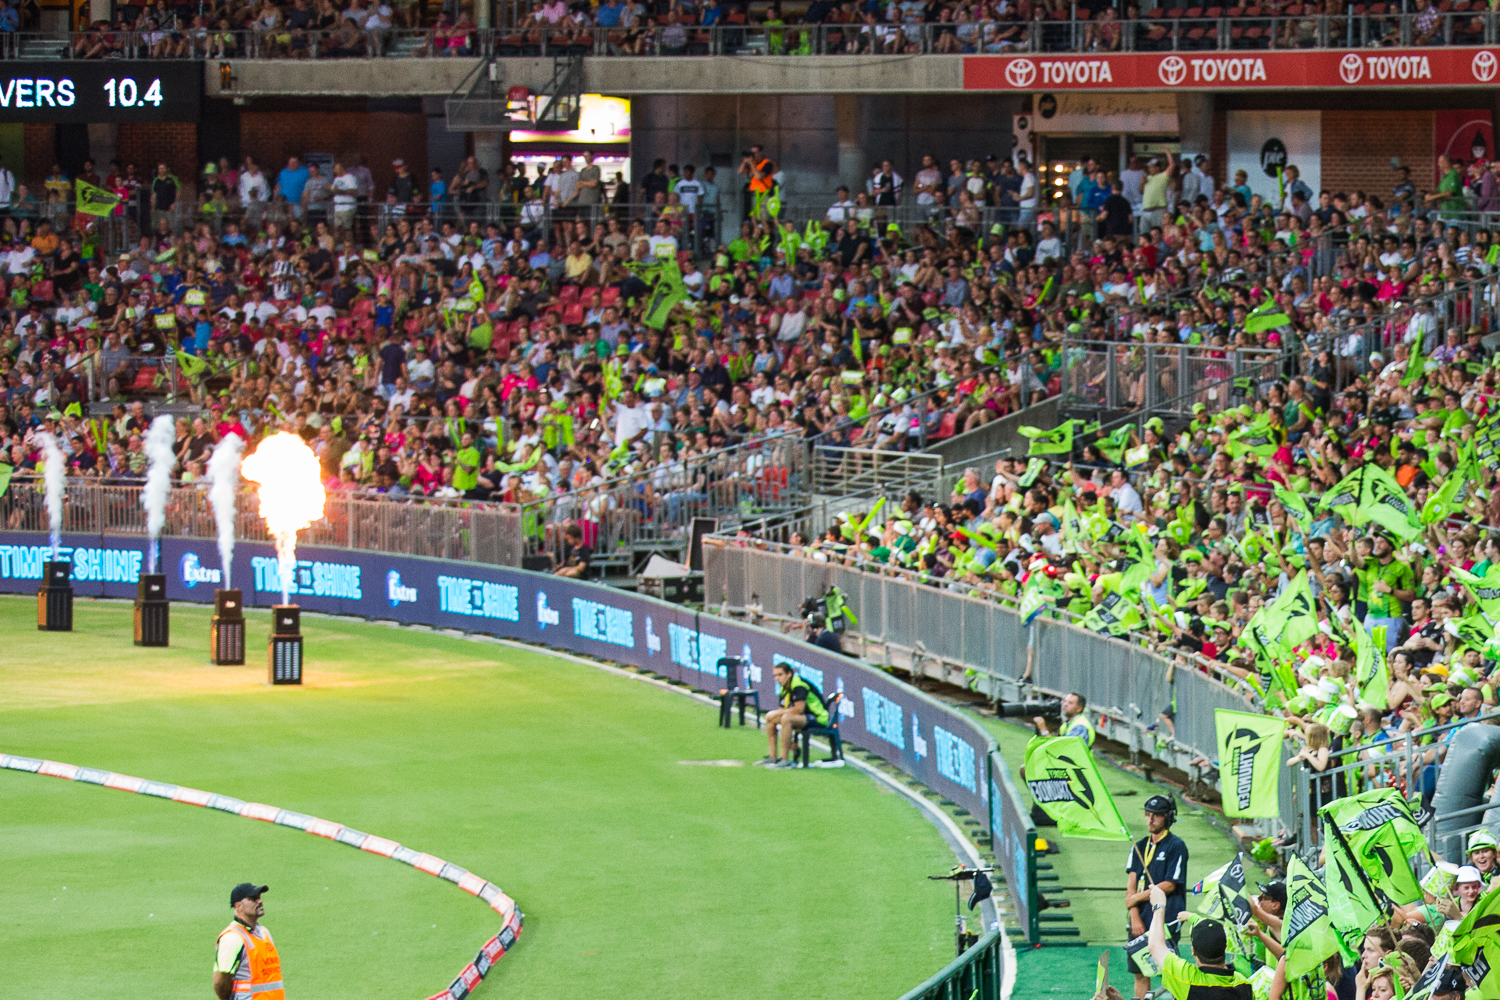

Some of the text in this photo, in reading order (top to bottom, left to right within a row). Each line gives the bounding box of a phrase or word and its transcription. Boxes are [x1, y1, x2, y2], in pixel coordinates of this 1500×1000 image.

[1040, 60, 1113, 83] TOYOTA
[1191, 58, 1267, 82] TOYOTA
[1366, 55, 1432, 79] TOYOTA
[0, 77, 164, 108] VERS 10.4
[1262, 146, 1286, 169] pie
[73, 547, 143, 583] SHINE
[183, 560, 222, 583] Extra
[312, 560, 362, 600] SHINE
